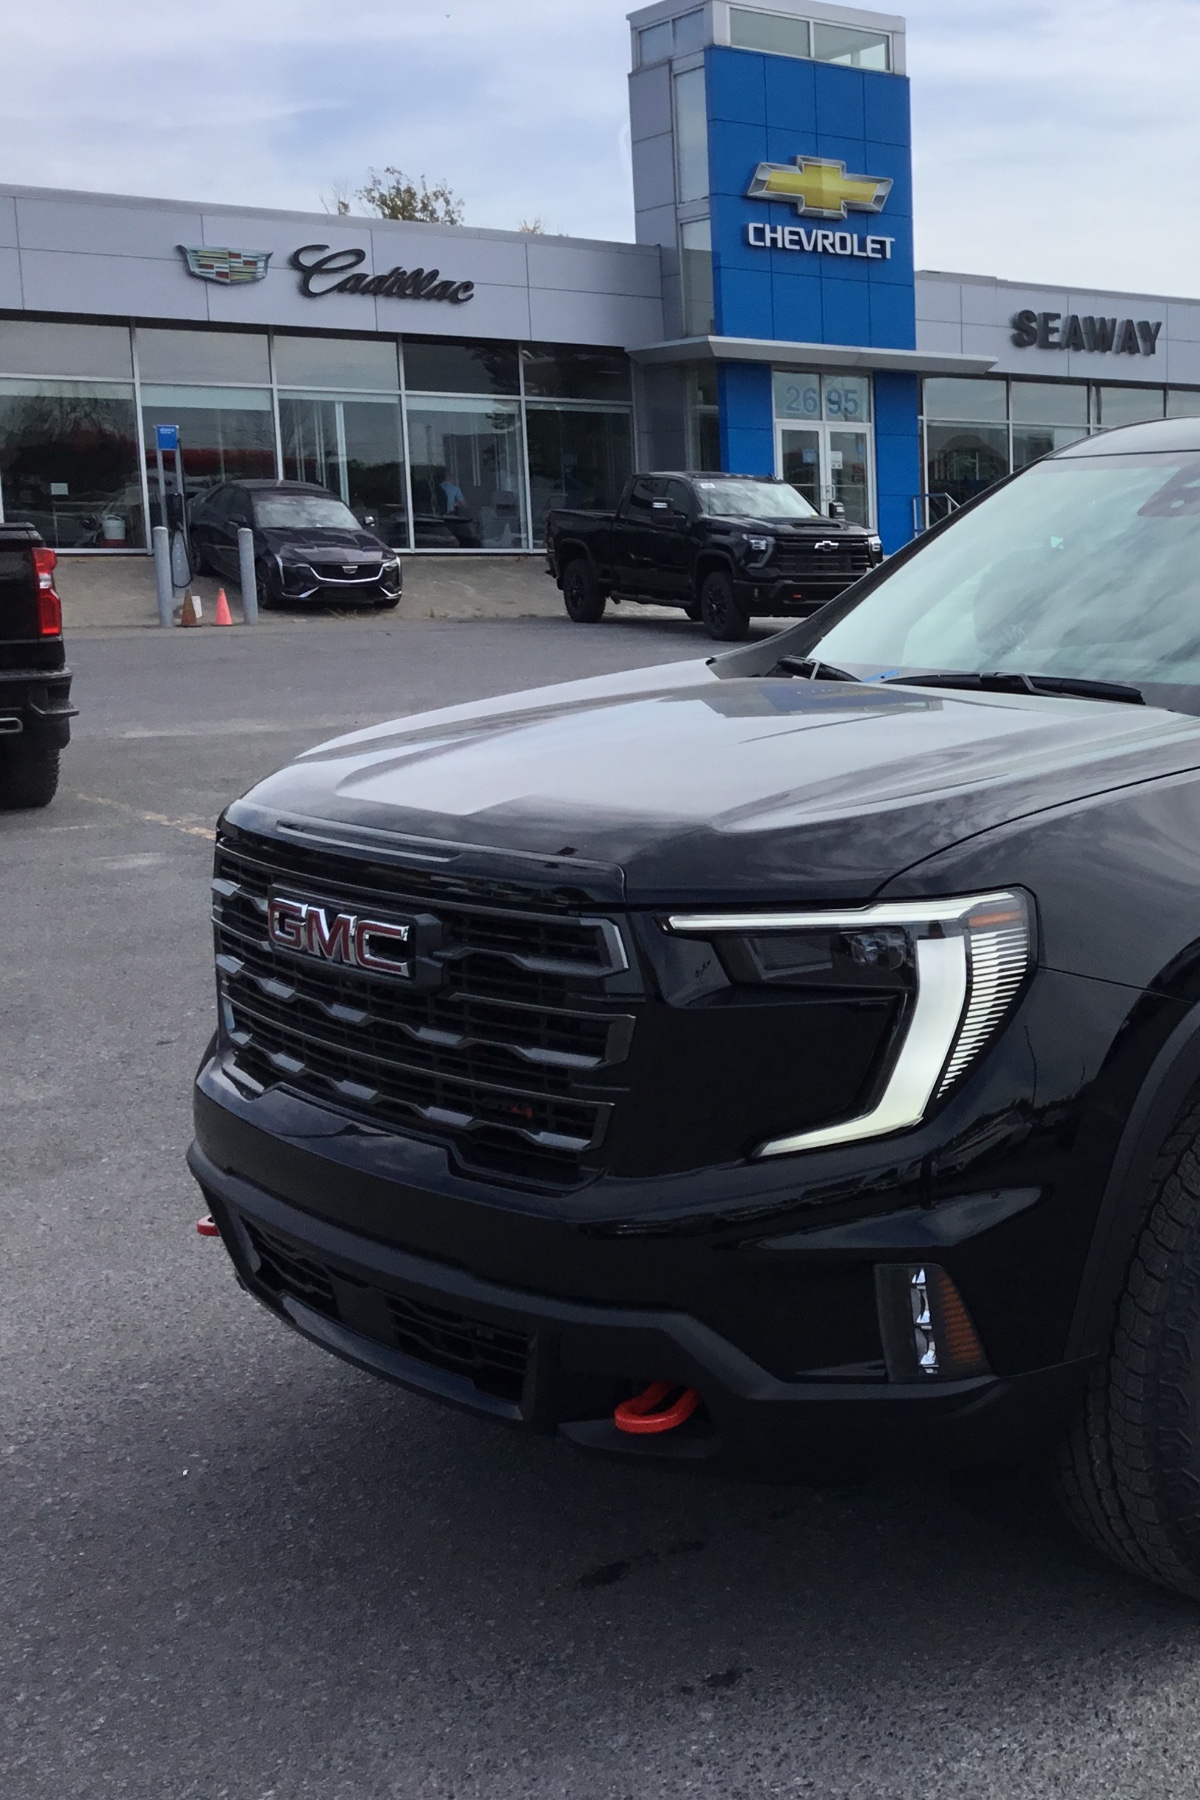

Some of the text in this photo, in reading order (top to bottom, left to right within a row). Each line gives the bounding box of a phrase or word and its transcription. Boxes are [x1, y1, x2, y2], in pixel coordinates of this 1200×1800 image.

[747, 222, 896, 260] CHEVROLET
[290, 244, 475, 306] Cadillac
[1010, 309, 1163, 356] SEAWAY
[785, 385, 859, 416] 2695
[266, 896, 411, 979] GMC
